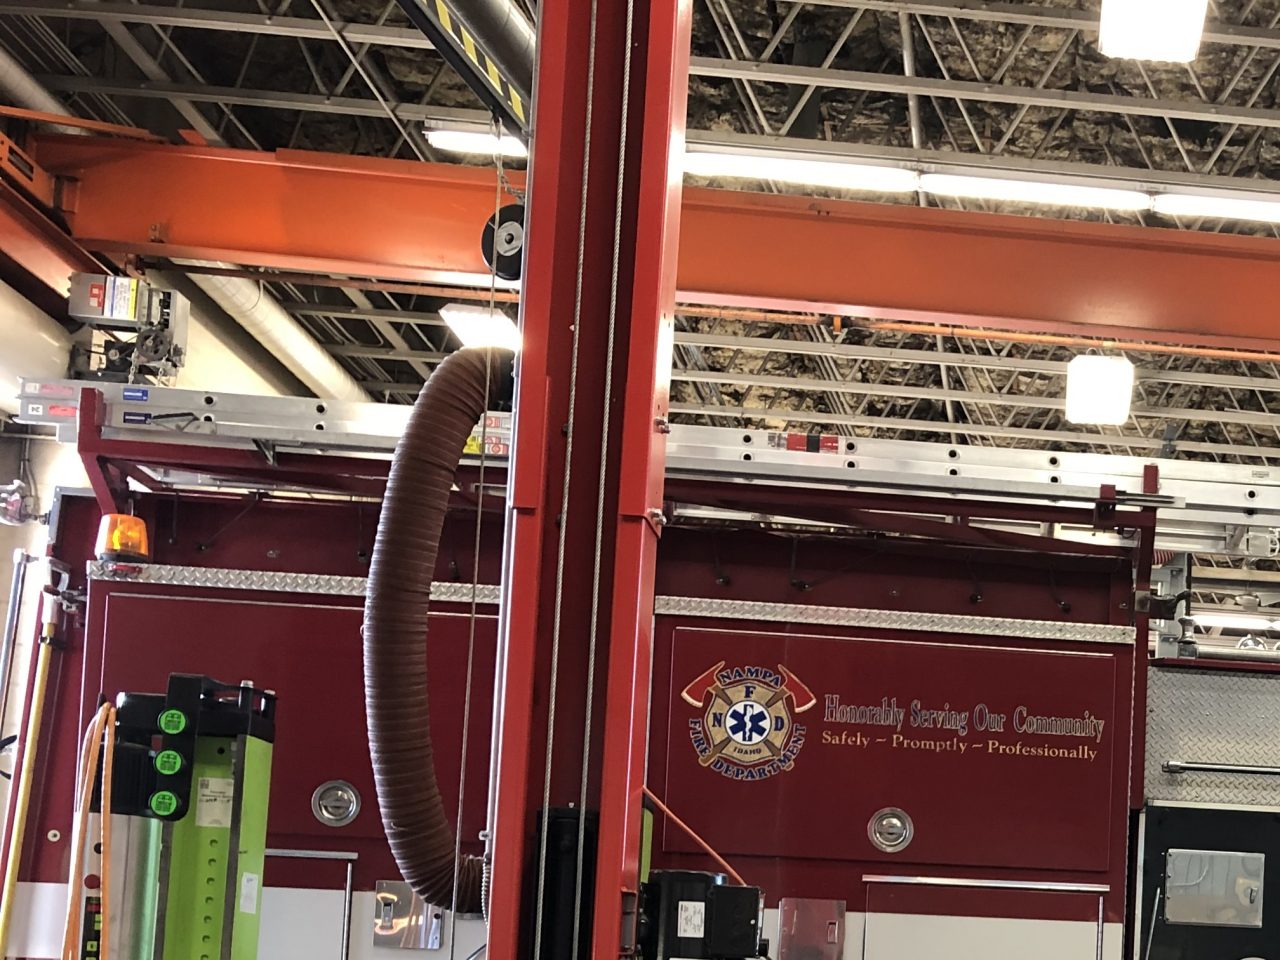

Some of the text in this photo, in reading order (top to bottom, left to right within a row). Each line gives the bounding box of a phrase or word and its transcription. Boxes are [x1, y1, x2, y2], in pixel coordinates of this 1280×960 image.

[718, 665, 782, 688] NAMPA
[744, 685, 756, 698] F
[712, 712, 785, 731] N D
[823, 693, 1105, 743] Honorably Serving Our Community
[689, 718, 713, 758] FIRE
[732, 746, 762, 755] IDAHO
[822, 730, 870, 749] Safely
[892, 734, 968, 753] Promptly
[987, 739, 1098, 762] Professionally
[711, 723, 807, 781] DEPARTMENT
